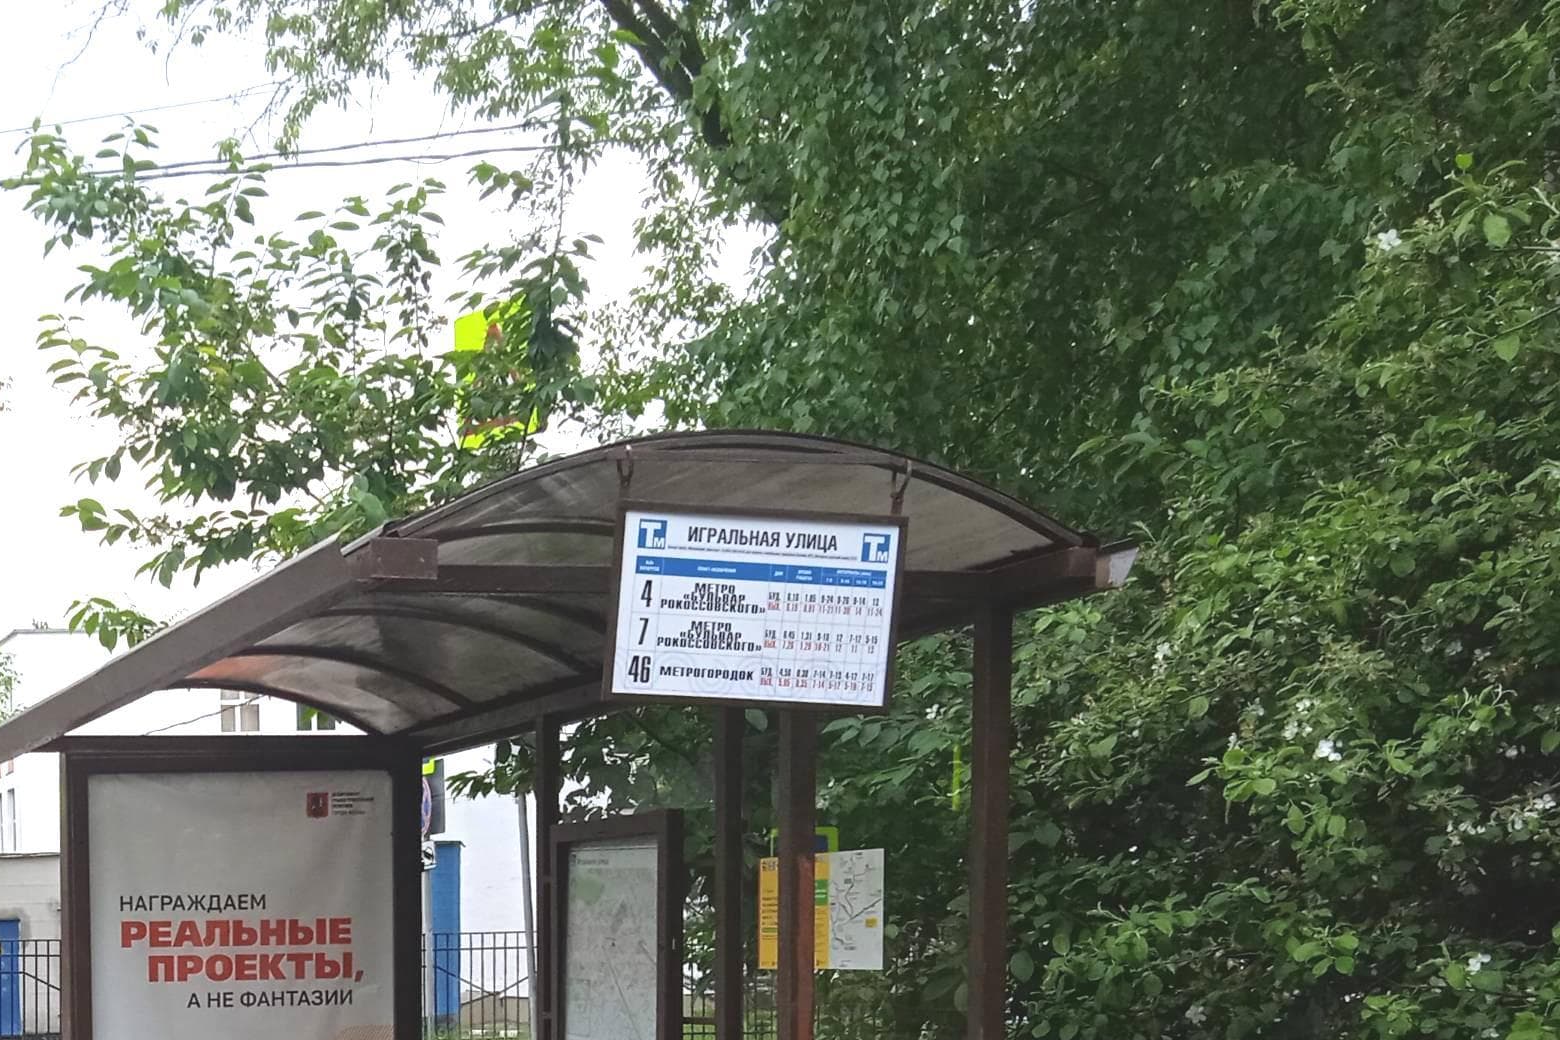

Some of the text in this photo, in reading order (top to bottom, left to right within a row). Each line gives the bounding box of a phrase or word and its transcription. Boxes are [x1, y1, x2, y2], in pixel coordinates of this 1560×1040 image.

[687, 526, 781, 548] ИГРАЛЬНАЯ
[786, 532, 838, 553] УЛИЦА
[640, 580, 653, 608] 4
[694, 583, 736, 594] МЕТРО
[638, 617, 649, 645] 7
[690, 621, 732, 632] МЕТРО
[628, 655, 652, 683] 46
[659, 666, 754, 681] МЕТРОГОРОДОК
[119, 894, 267, 914] НАГРАЖДАЕМ
[120, 917, 353, 949] РЕАЛЬНЫЕ
[148, 952, 364, 984] ПРОЕКТЫ,
[187, 989, 353, 1009] А НЕ ФАНТАЗИИ
